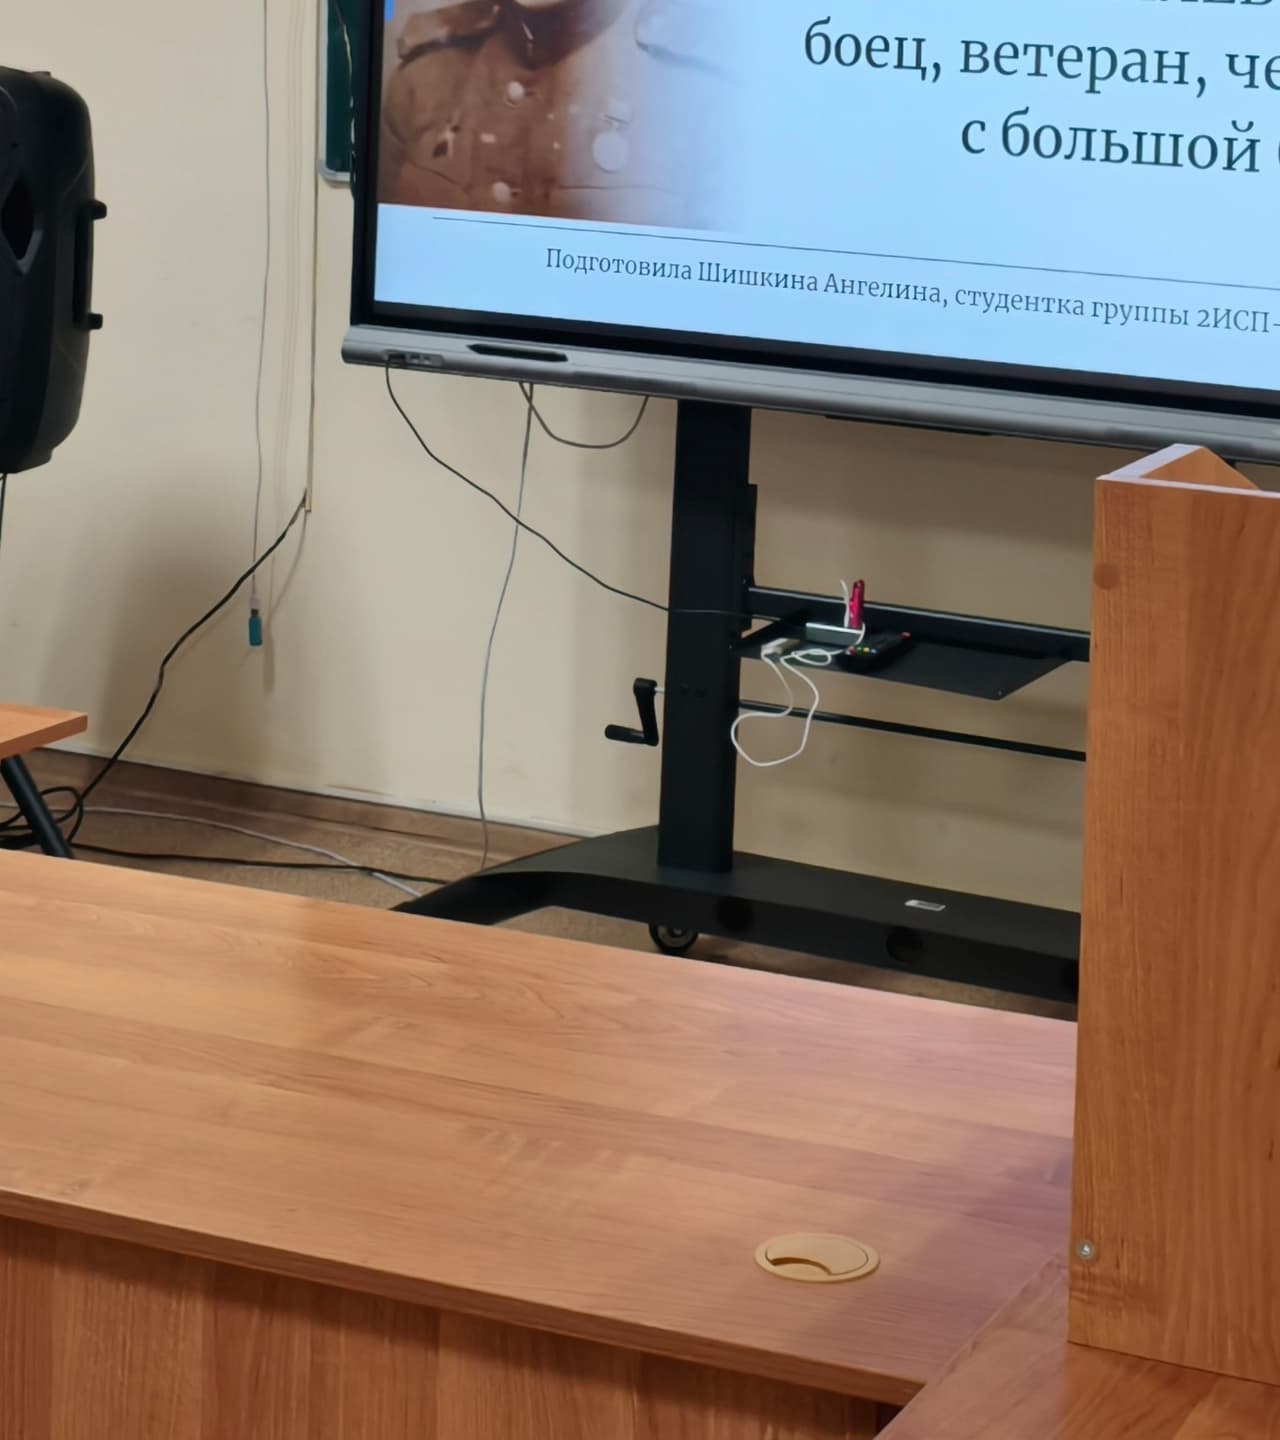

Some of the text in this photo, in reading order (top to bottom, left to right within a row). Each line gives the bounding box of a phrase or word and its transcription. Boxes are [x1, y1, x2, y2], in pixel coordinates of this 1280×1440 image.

[804, 15, 942, 84] боец,
[959, 39, 1207, 99] ветеран,
[961, 119, 987, 155] с
[1001, 106, 1262, 174] большой
[546, 247, 692, 282] Подготовила
[697, 261, 819, 292] Шишкина
[823, 272, 948, 309] Ангелина,
[955, 288, 1085, 316] студентка
[1091, 301, 1190, 330] группы
